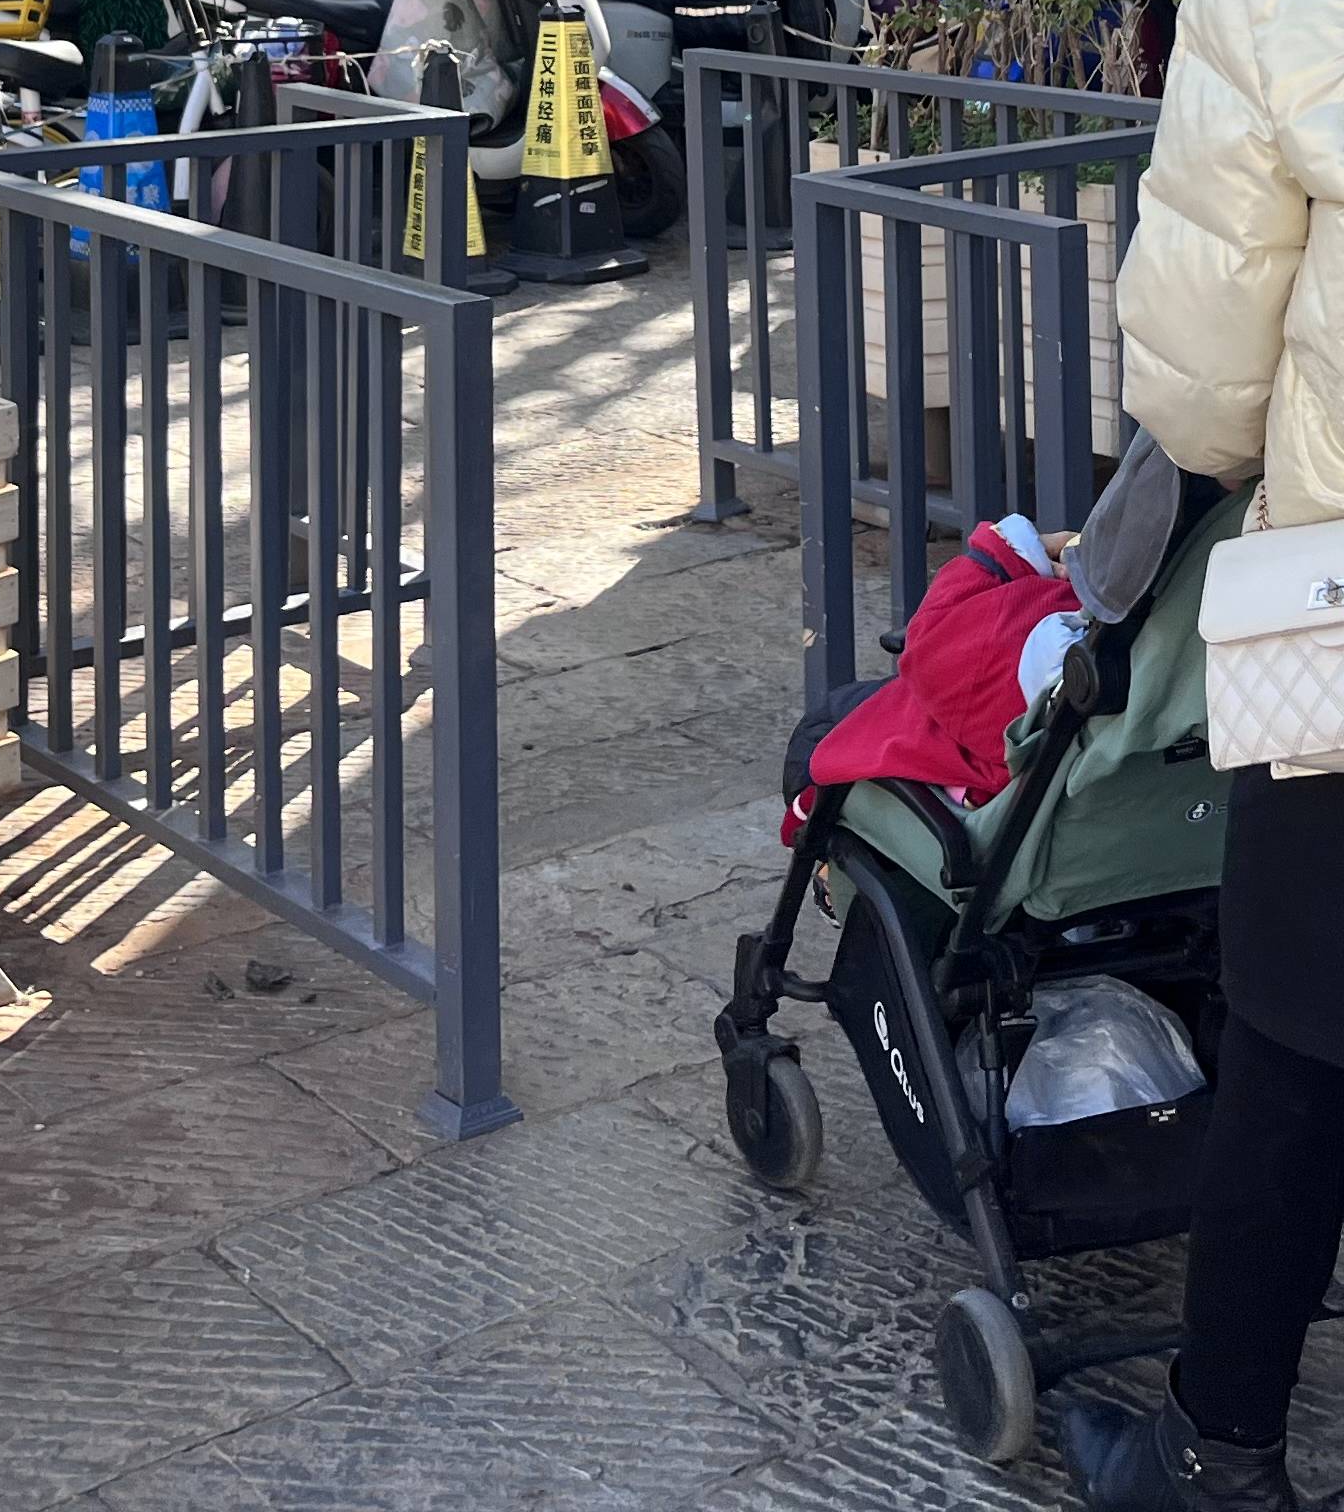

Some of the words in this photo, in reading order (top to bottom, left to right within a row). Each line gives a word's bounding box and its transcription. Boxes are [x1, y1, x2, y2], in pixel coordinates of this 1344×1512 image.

[536, 33, 557, 145] 三叉神经痛
